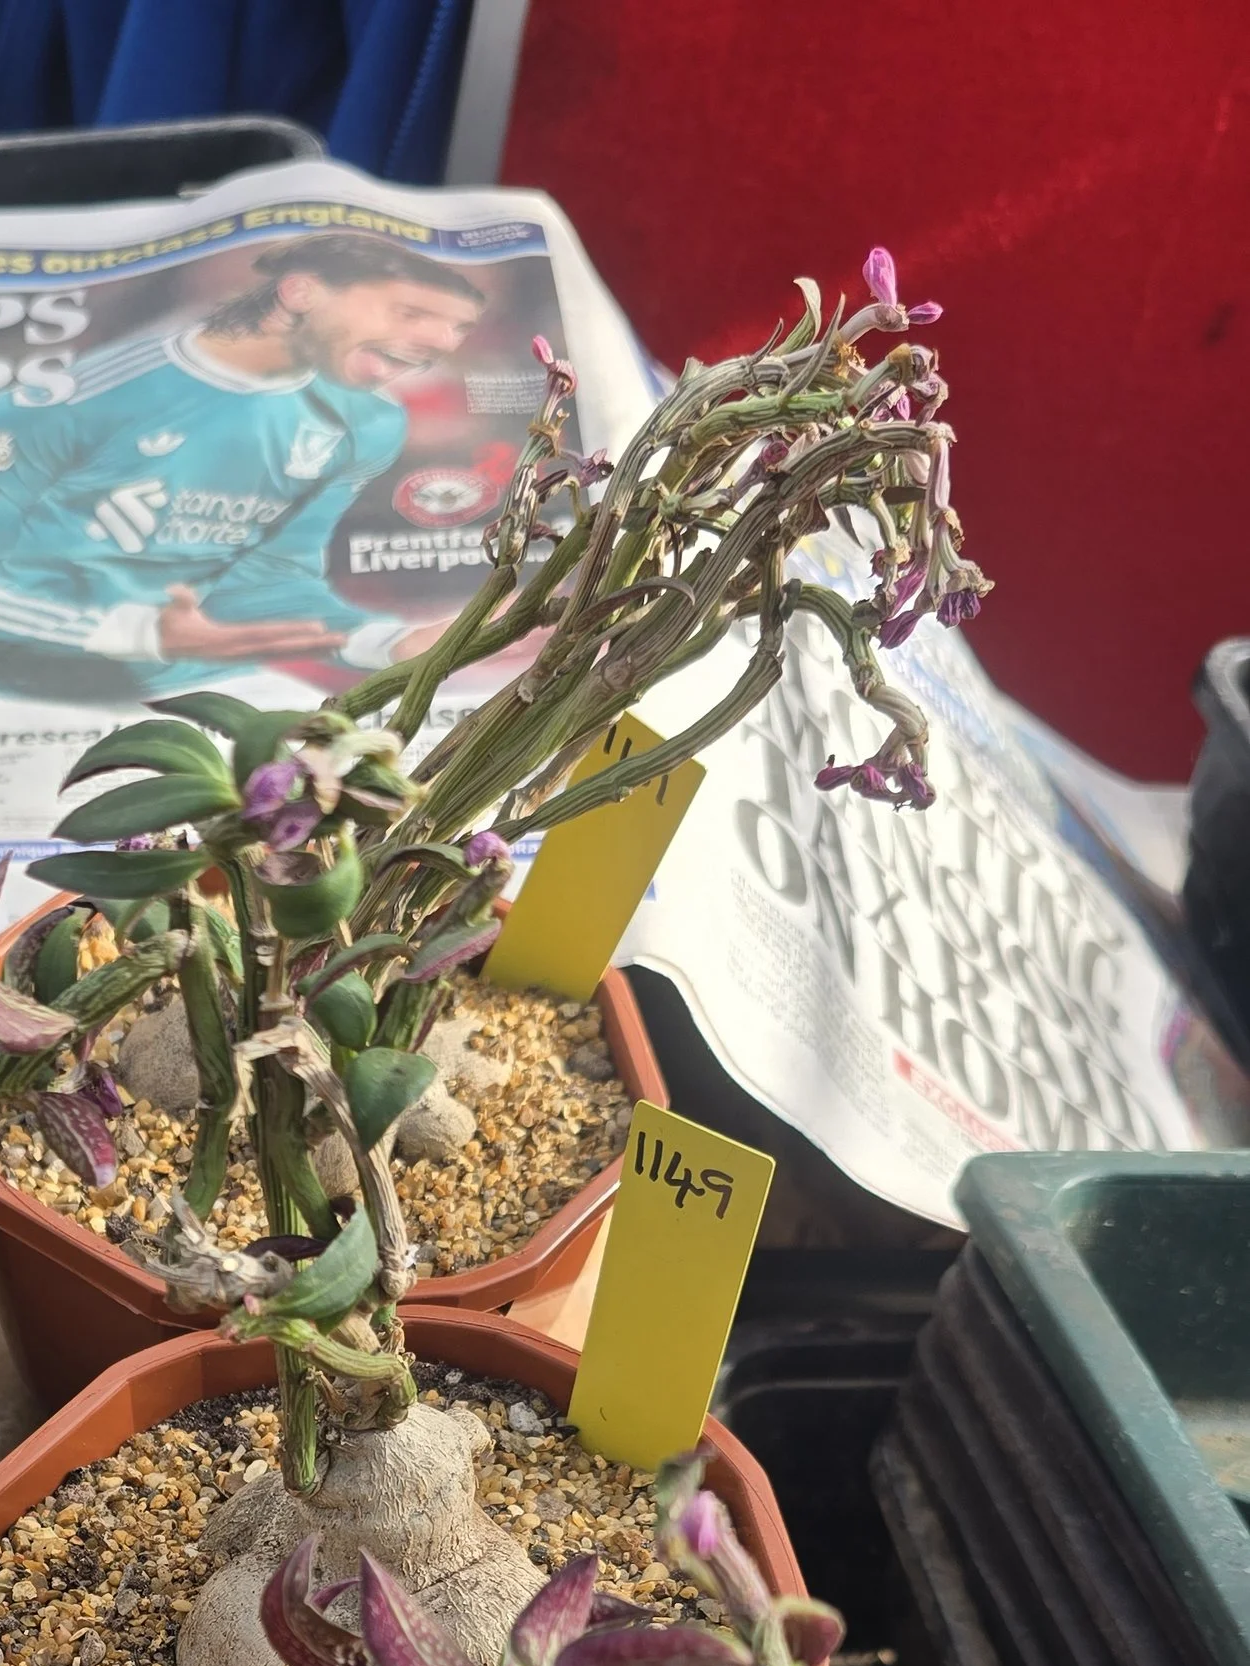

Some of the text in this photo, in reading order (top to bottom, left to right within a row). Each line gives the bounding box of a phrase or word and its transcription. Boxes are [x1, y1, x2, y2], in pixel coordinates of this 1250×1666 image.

[43, 216, 235, 276] outclass
[243, 201, 433, 243] England
[349, 530, 488, 553] Brentfo
[732, 797, 856, 989] ON
[634, 1131, 734, 1220] 1149
